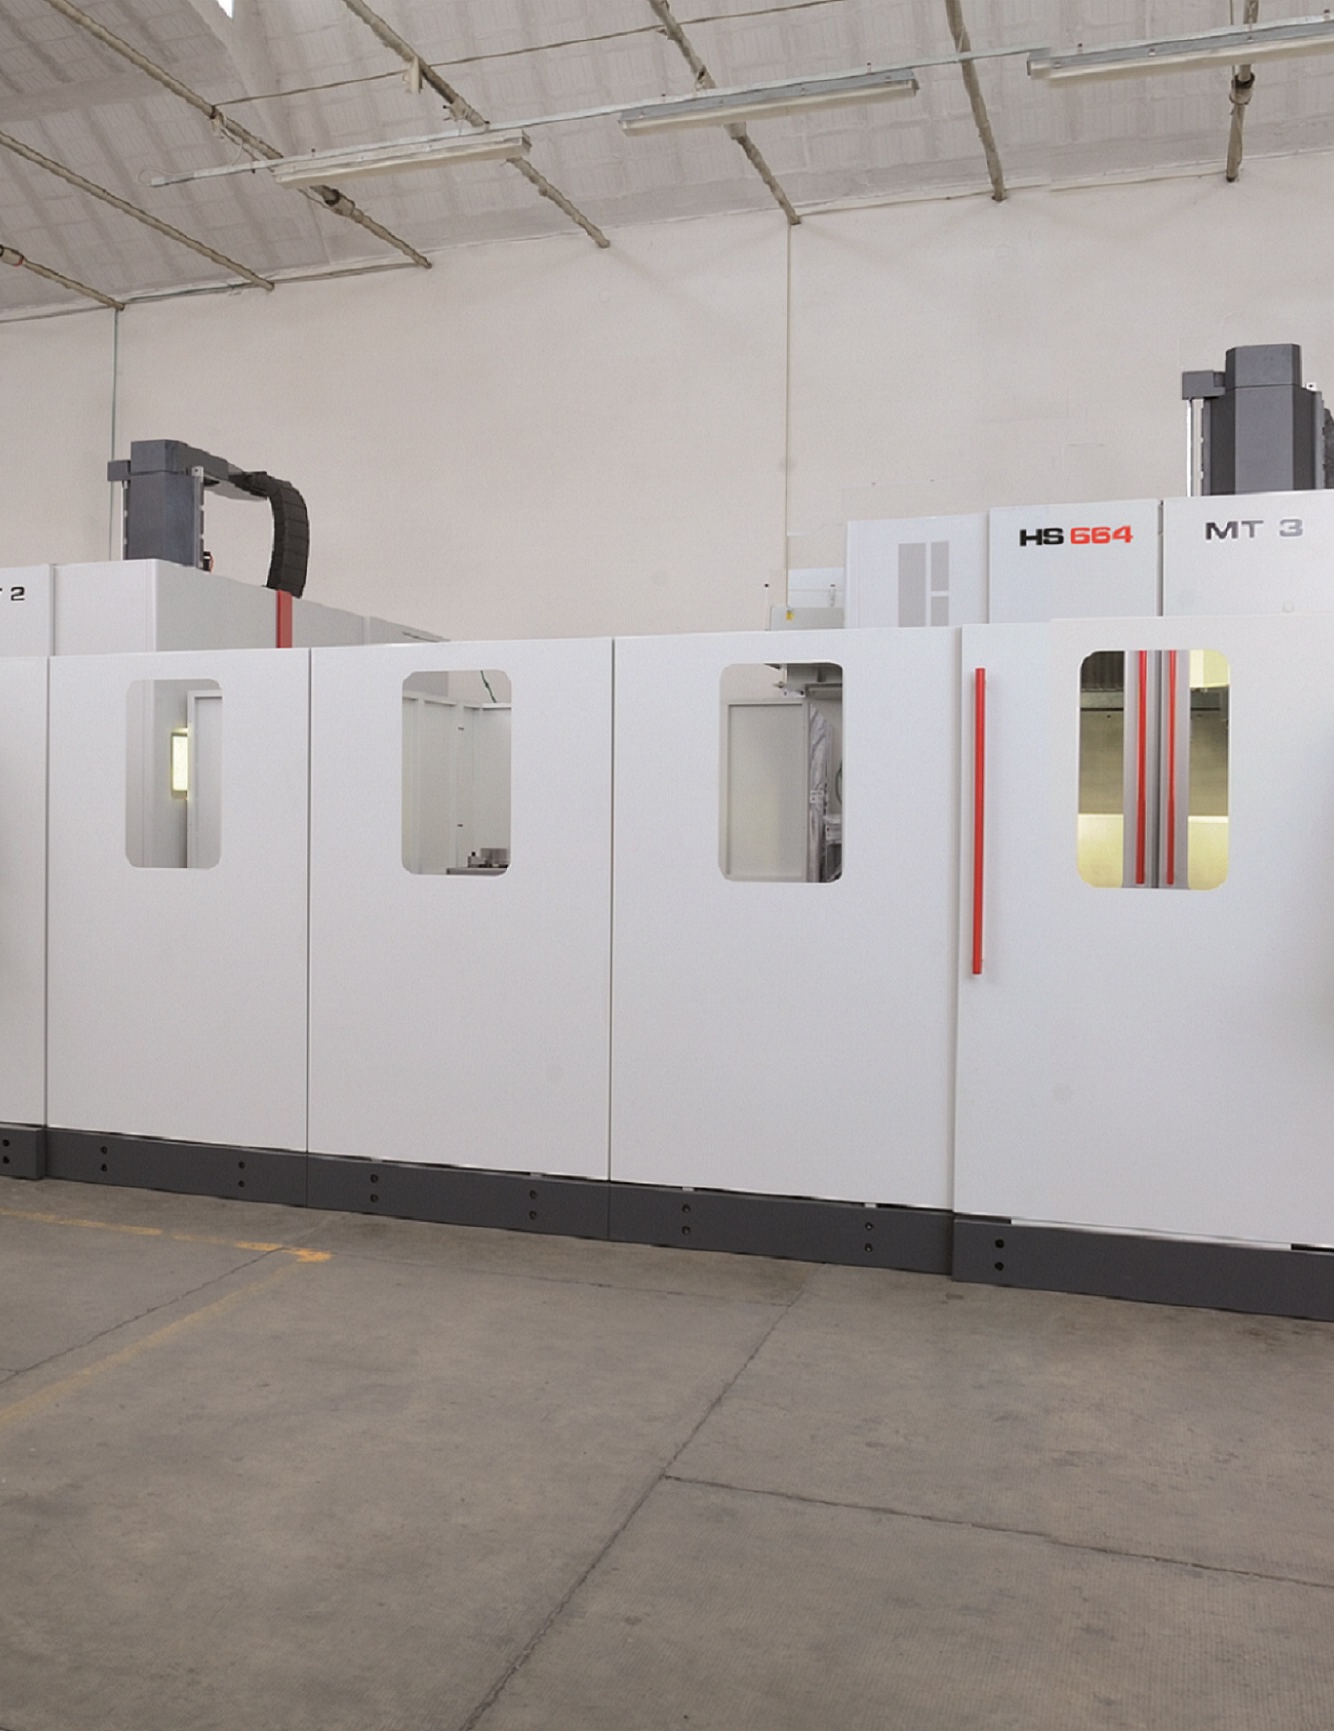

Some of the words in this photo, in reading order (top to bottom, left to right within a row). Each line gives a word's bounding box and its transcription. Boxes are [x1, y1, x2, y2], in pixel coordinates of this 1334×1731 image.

[1204, 520, 1264, 540] MT
[1278, 518, 1304, 538] 3
[10, 586, 26, 601] 2
